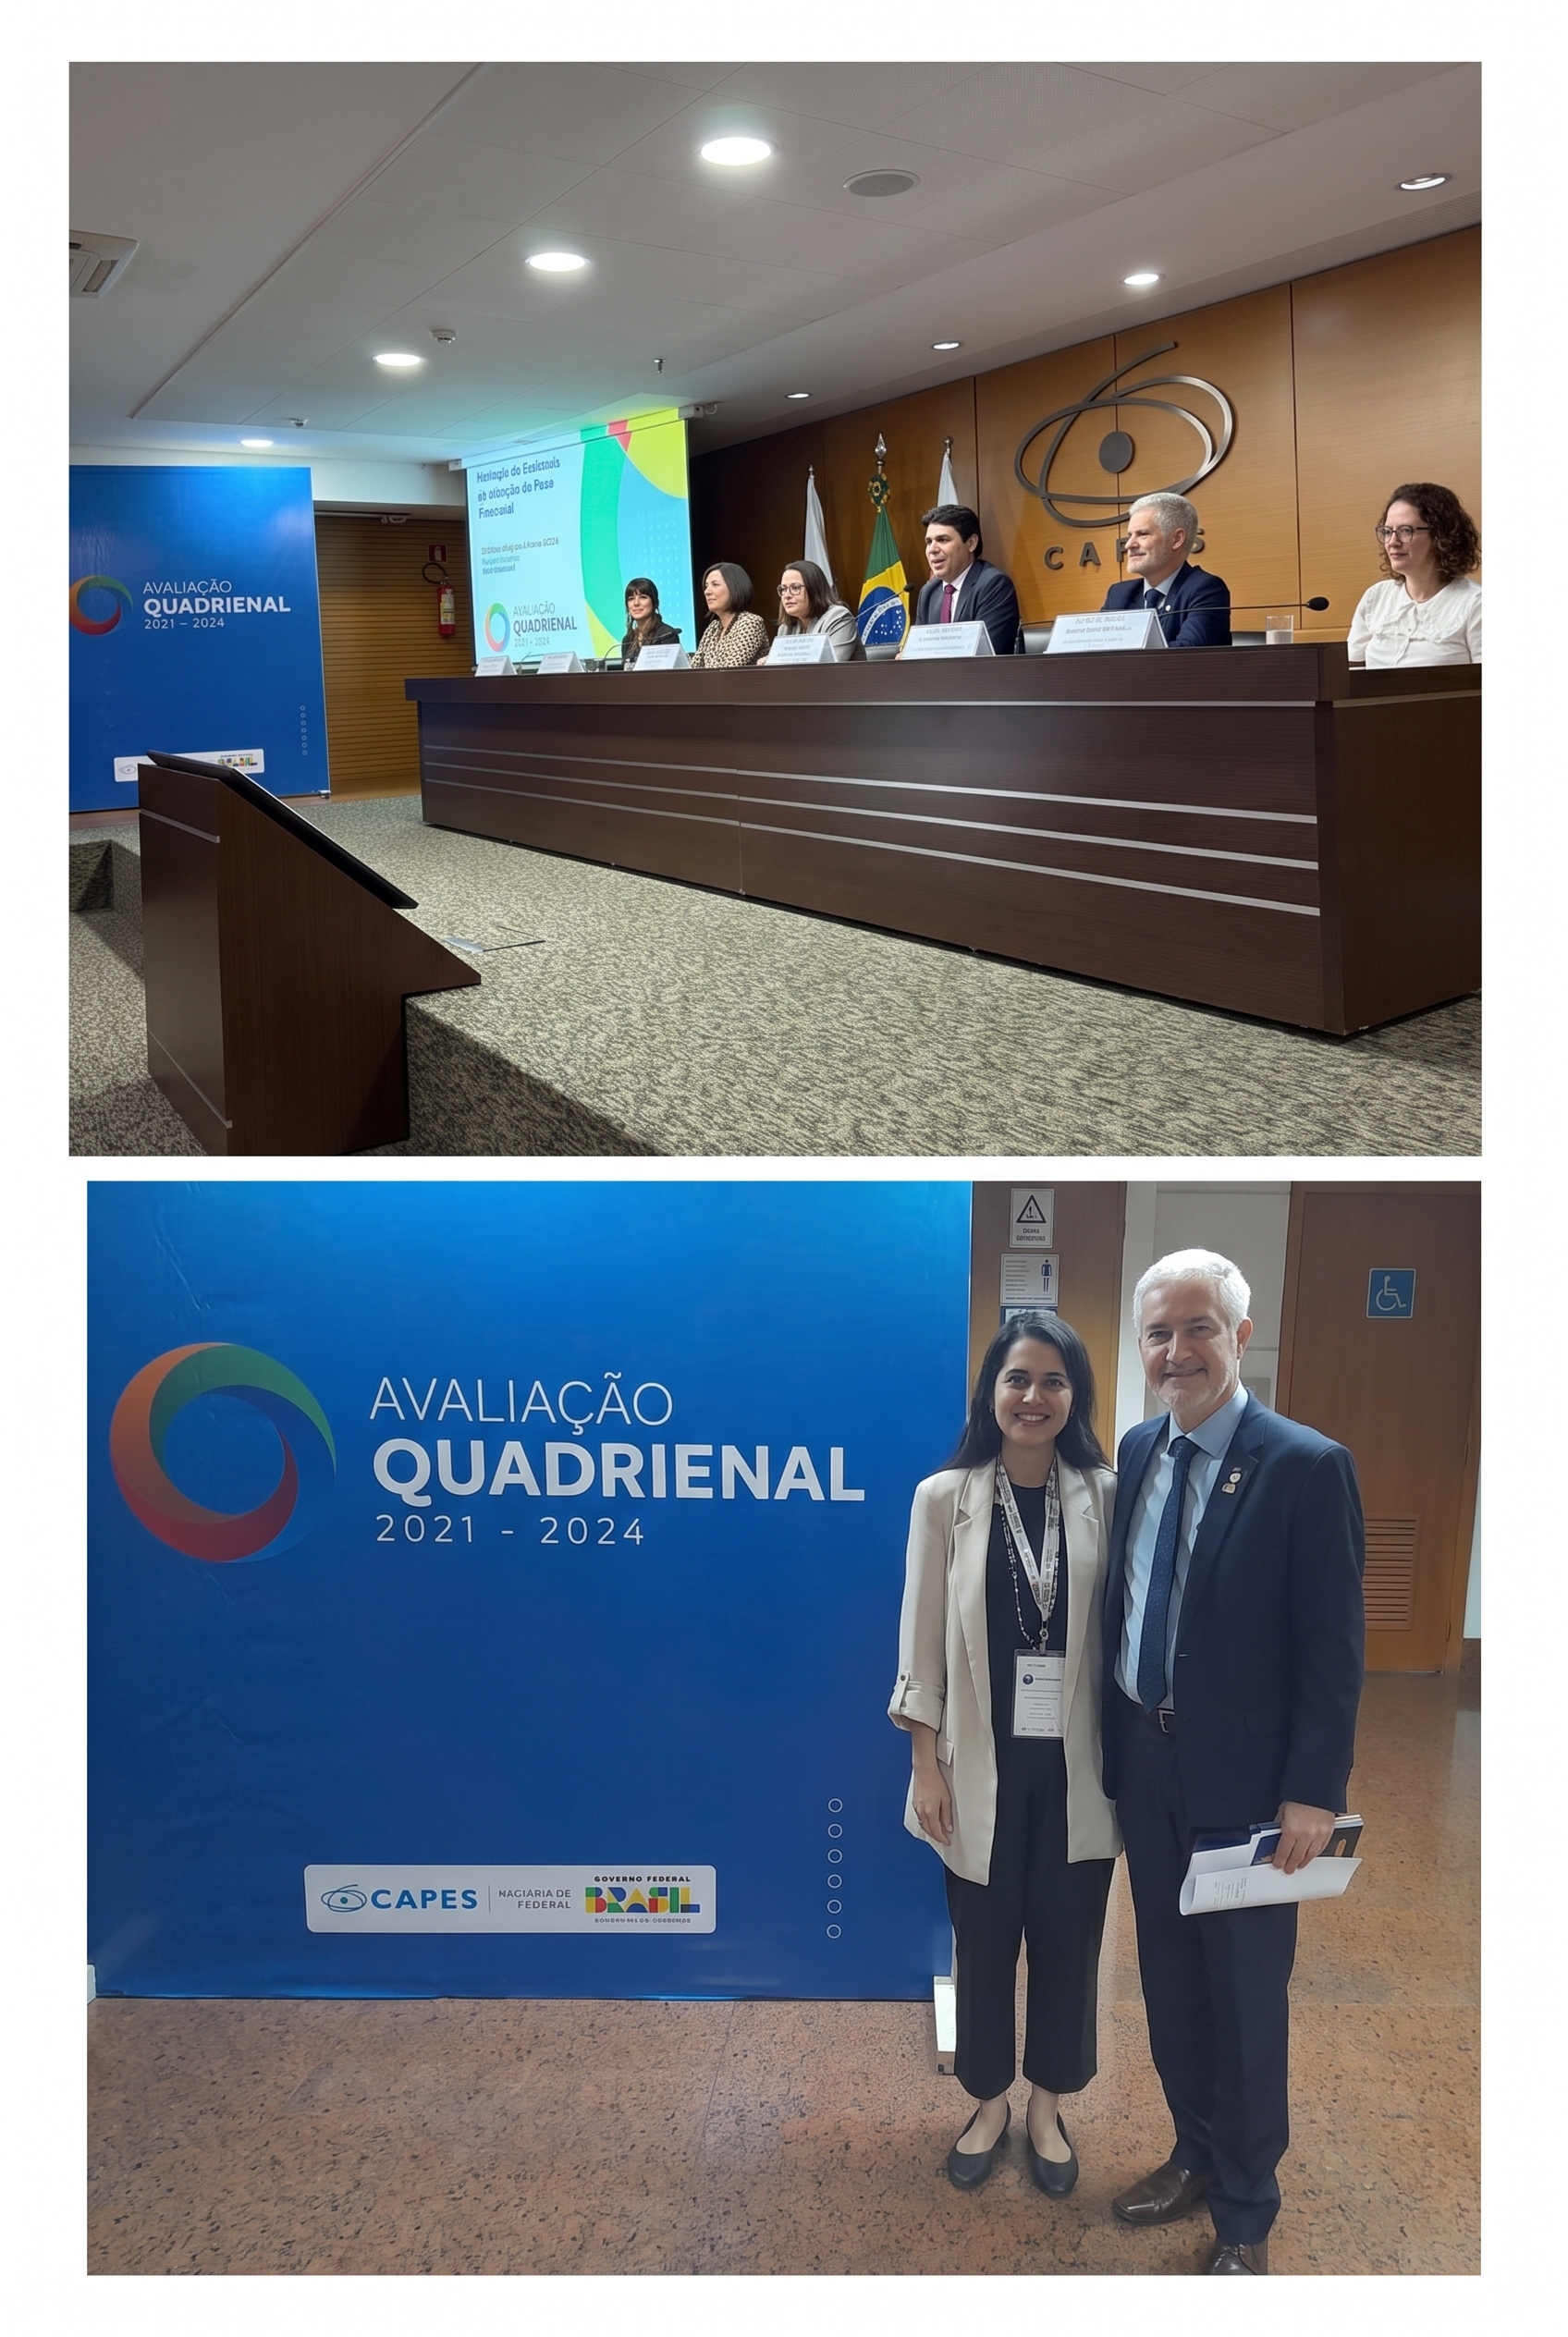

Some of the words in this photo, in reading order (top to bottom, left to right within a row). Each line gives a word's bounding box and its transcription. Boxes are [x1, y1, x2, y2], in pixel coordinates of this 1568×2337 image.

[142, 579, 232, 596] AVALIAÇÃO
[143, 596, 291, 618] QUADRIENAL
[144, 618, 175, 630] 2021
[192, 617, 225, 629] 2024
[513, 616, 578, 637] QUADRIENAL
[370, 1372, 674, 1436] AVALIAÇÃO
[373, 1438, 865, 1508] QUADRIENAL
[375, 1513, 474, 1544] 2021
[539, 1516, 645, 1546] 2024
[371, 1889, 478, 1910] CAPES
[556, 1889, 571, 1898] DE
[584, 1886, 701, 1914] BRASIL
[518, 1900, 571, 1909] FEDERAL
